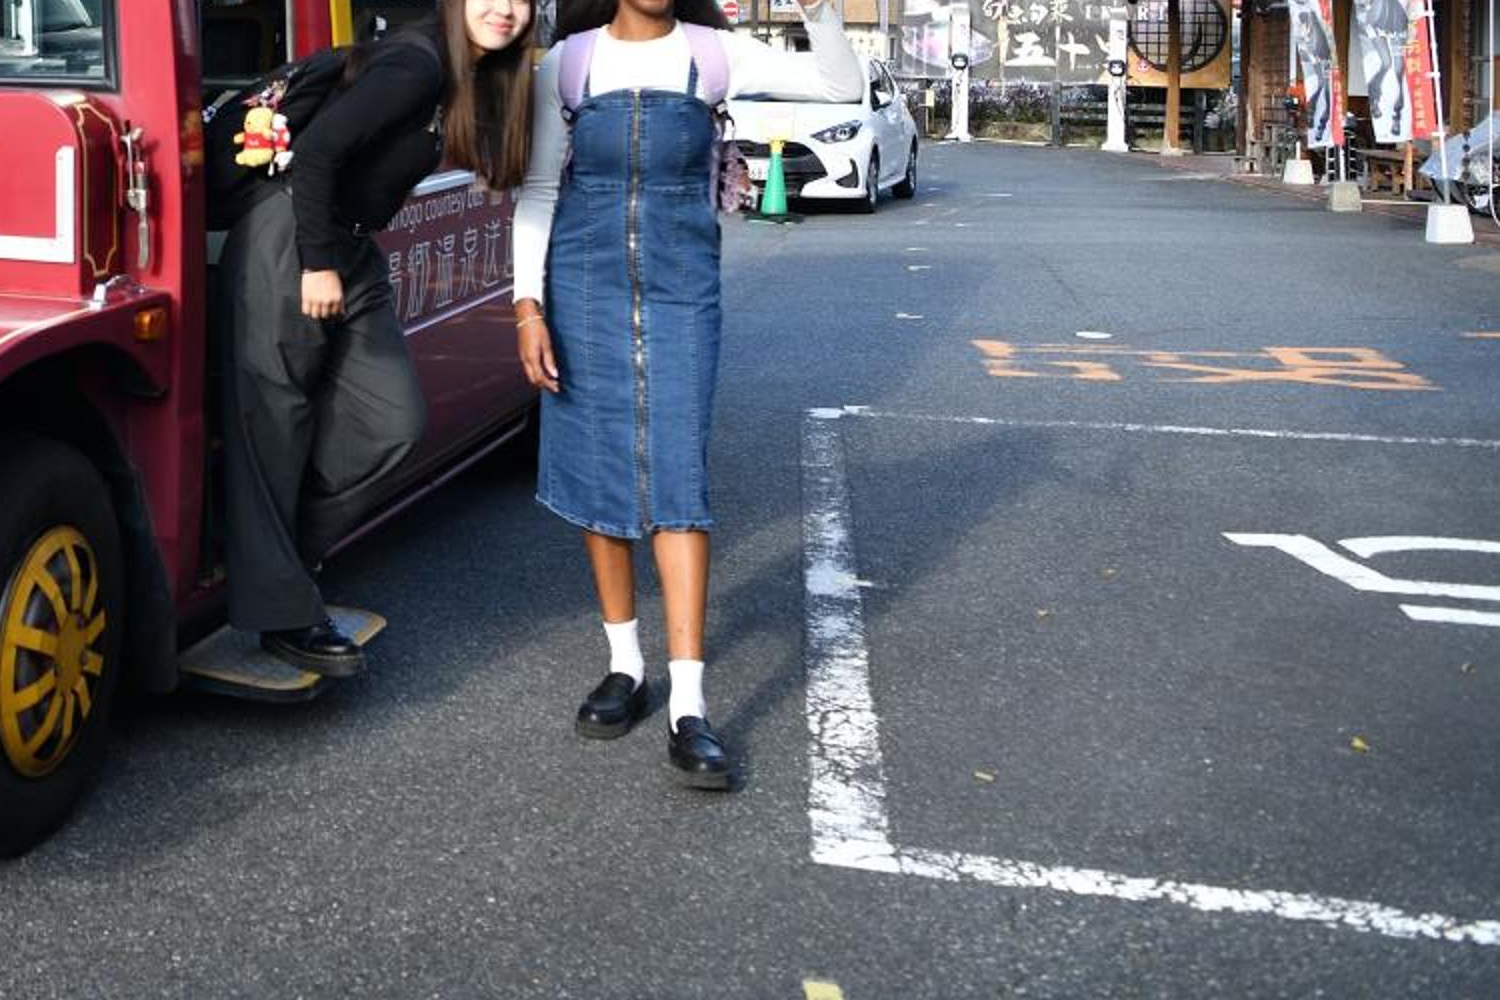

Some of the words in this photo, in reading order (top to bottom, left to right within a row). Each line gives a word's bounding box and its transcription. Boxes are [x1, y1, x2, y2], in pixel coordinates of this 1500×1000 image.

[388, 216, 513, 324] 湯郷温泉送
